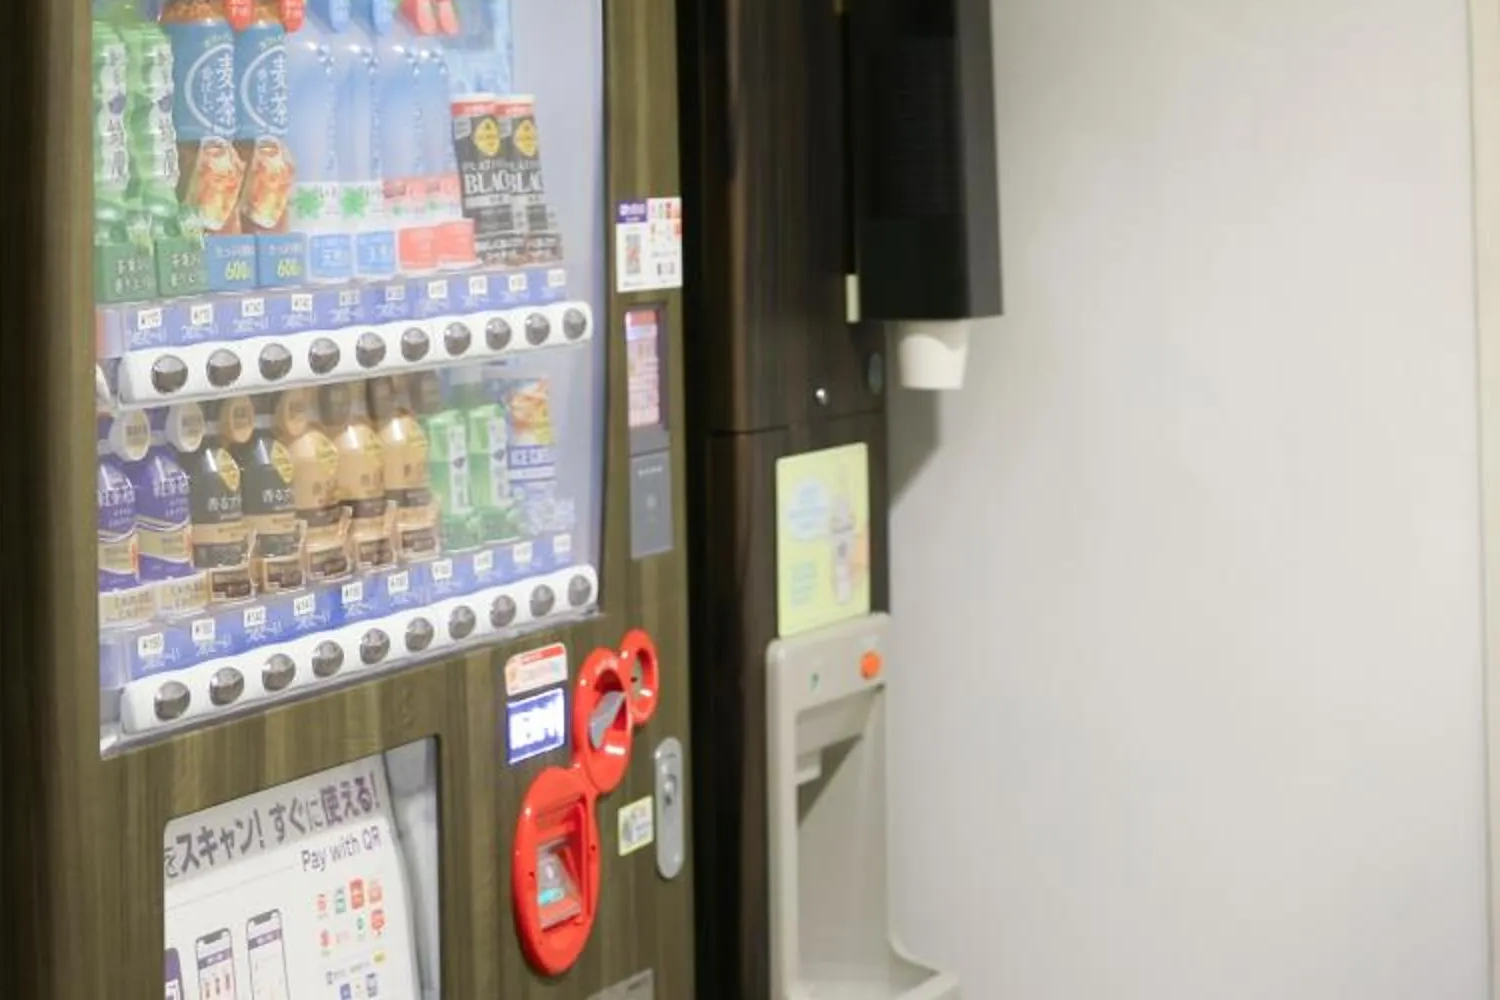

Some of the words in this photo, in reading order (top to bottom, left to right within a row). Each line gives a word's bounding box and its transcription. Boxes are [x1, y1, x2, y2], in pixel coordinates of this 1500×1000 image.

[269, 770, 381, 844] すぐに使える!
[301, 849, 327, 873] Pay
[329, 832, 361, 862] with
[362, 824, 382, 851] QR
